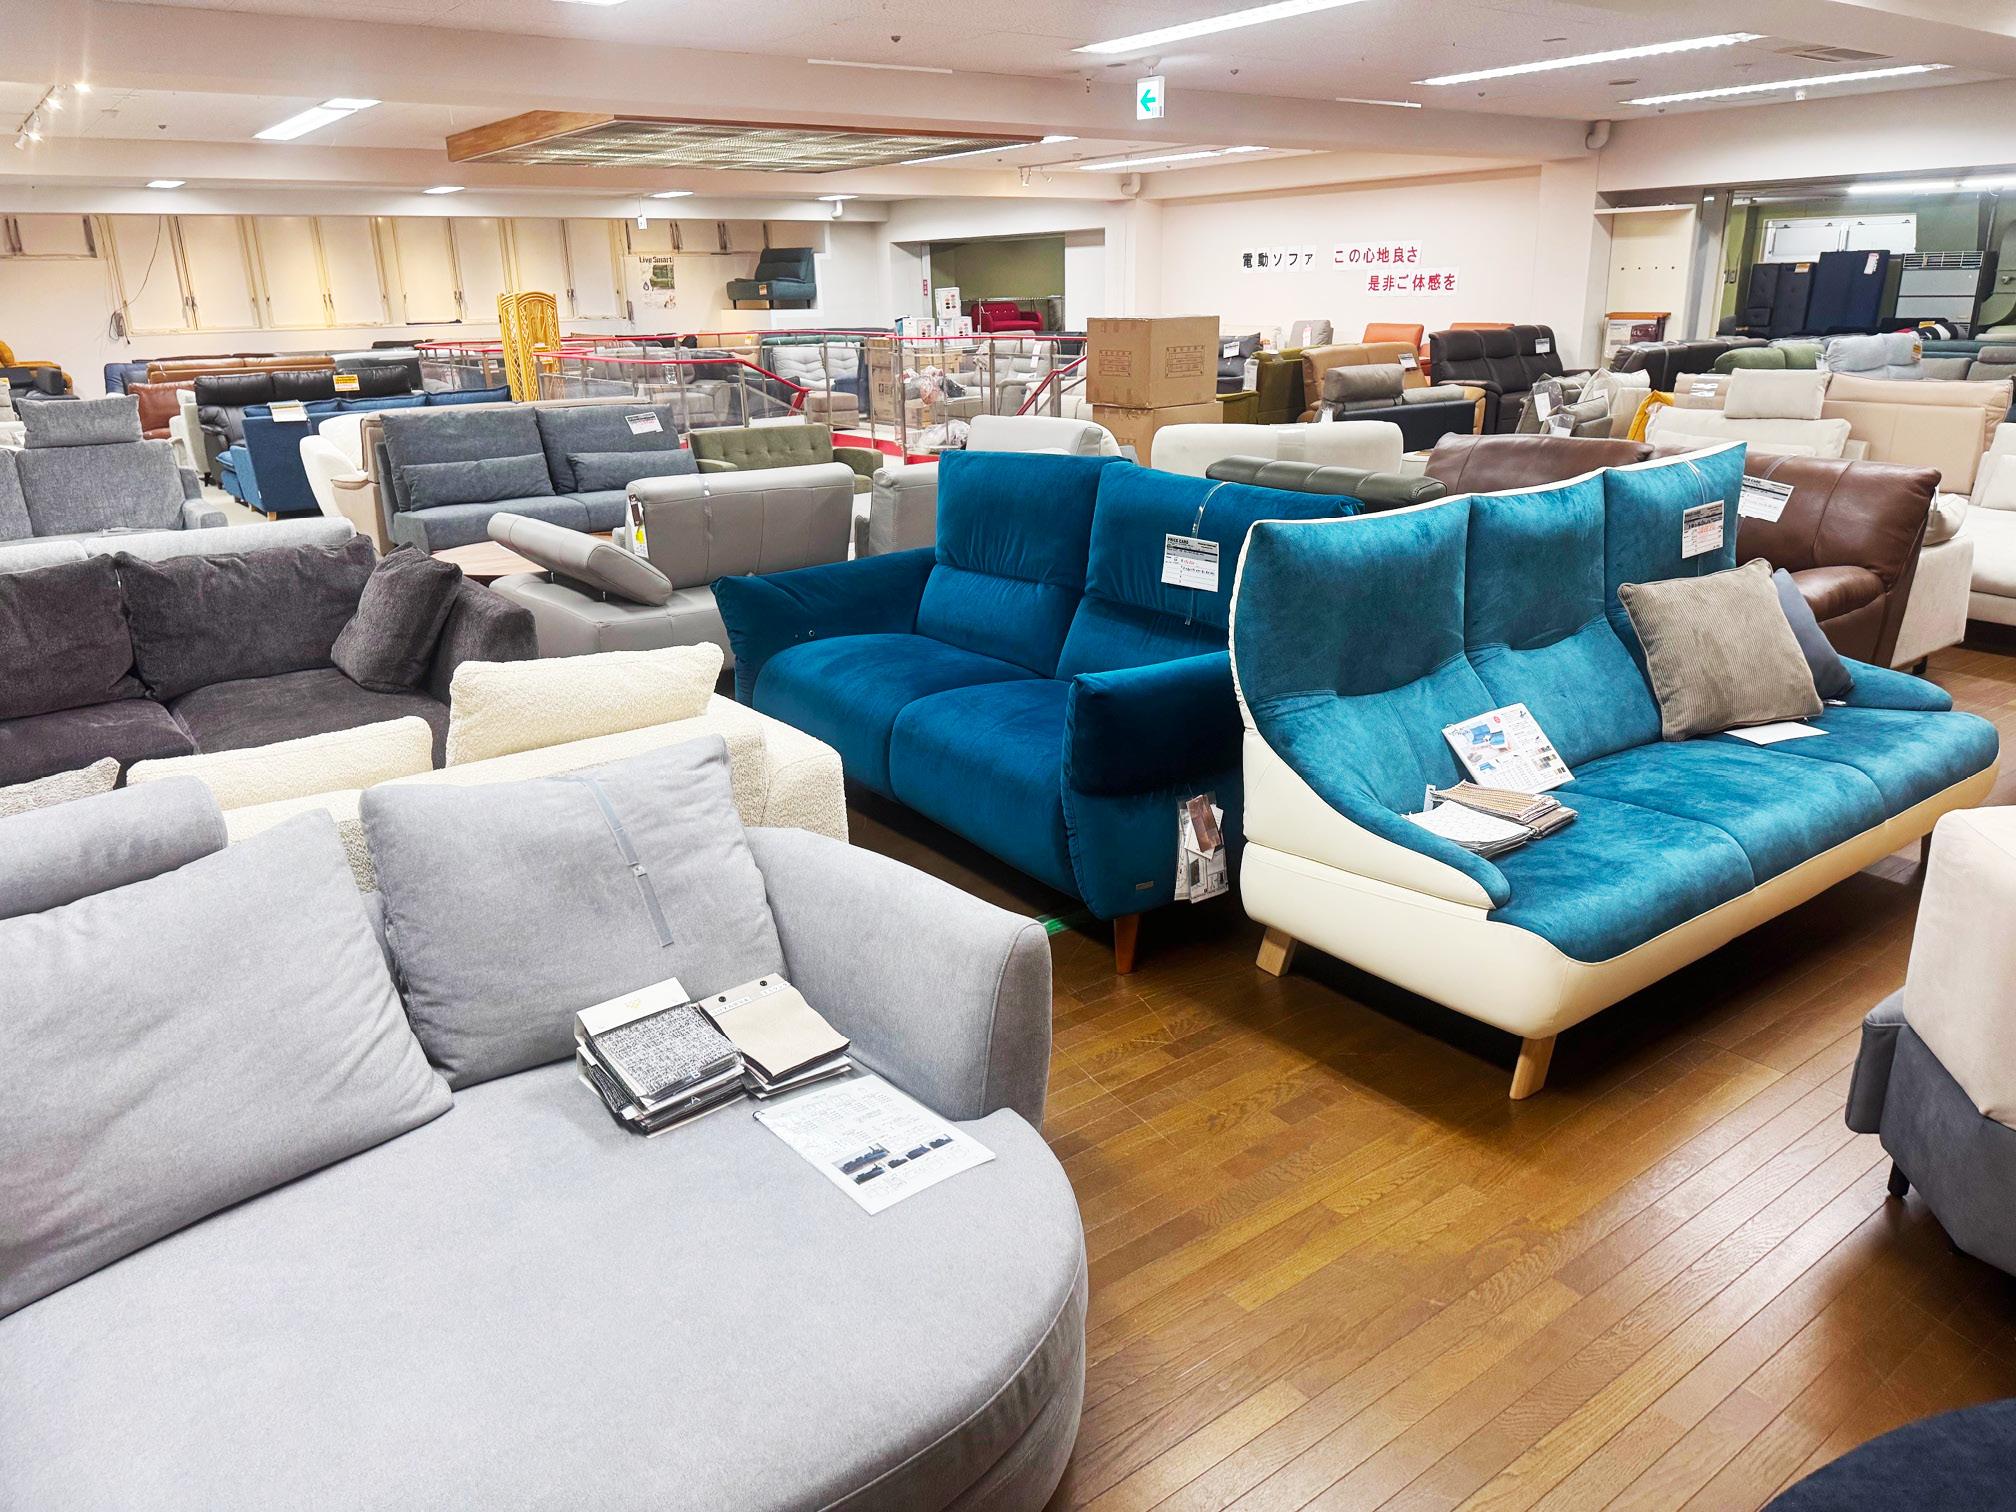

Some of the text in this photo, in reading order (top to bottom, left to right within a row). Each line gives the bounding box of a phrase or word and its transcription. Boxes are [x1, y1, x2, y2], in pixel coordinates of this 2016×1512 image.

[1242, 246, 1418, 269] 電動ソファ この心地良さ
[1367, 273, 1456, 291] 是非ご体感を
